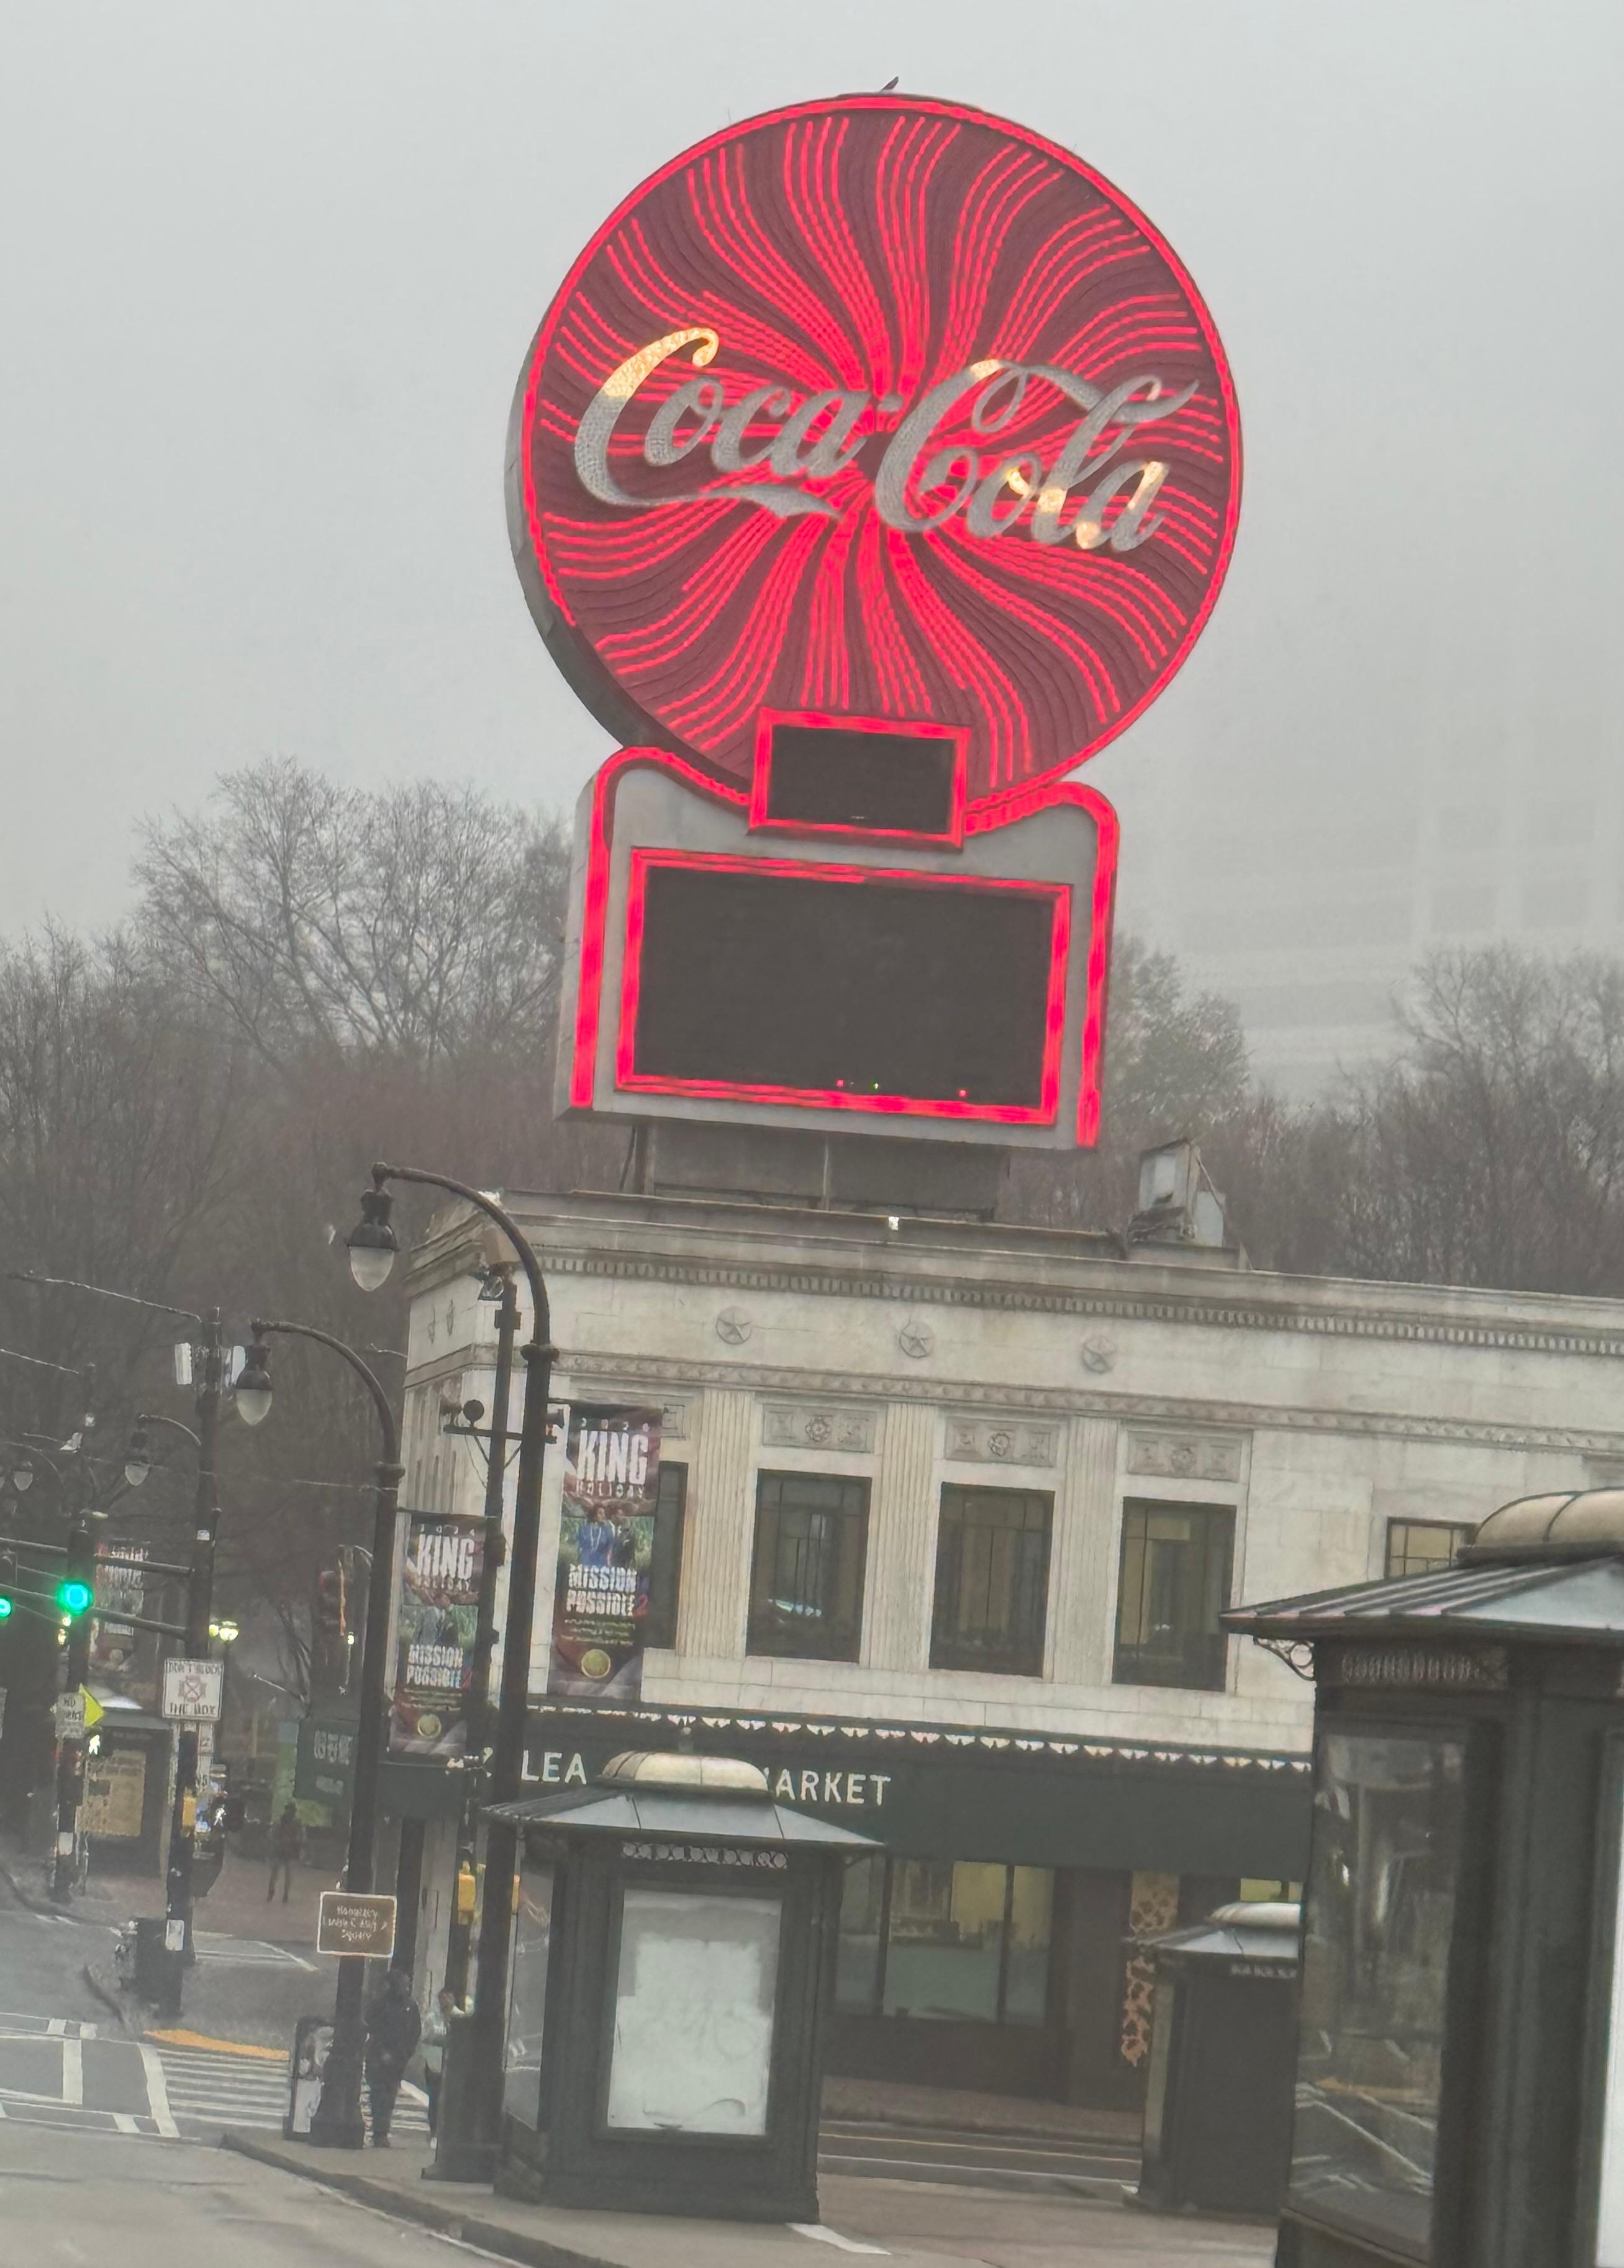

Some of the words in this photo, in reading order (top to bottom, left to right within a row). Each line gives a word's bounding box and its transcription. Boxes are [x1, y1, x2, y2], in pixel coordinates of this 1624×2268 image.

[573, 327, 1201, 552] Coca-Cola
[577, 1429, 648, 1485] KING
[417, 1534, 474, 1580] KING
[568, 1564, 637, 1592] MISSION
[409, 1644, 463, 1668] MISSION
[520, 1749, 587, 1785] LEA
[764, 1767, 892, 1806] ARKET
